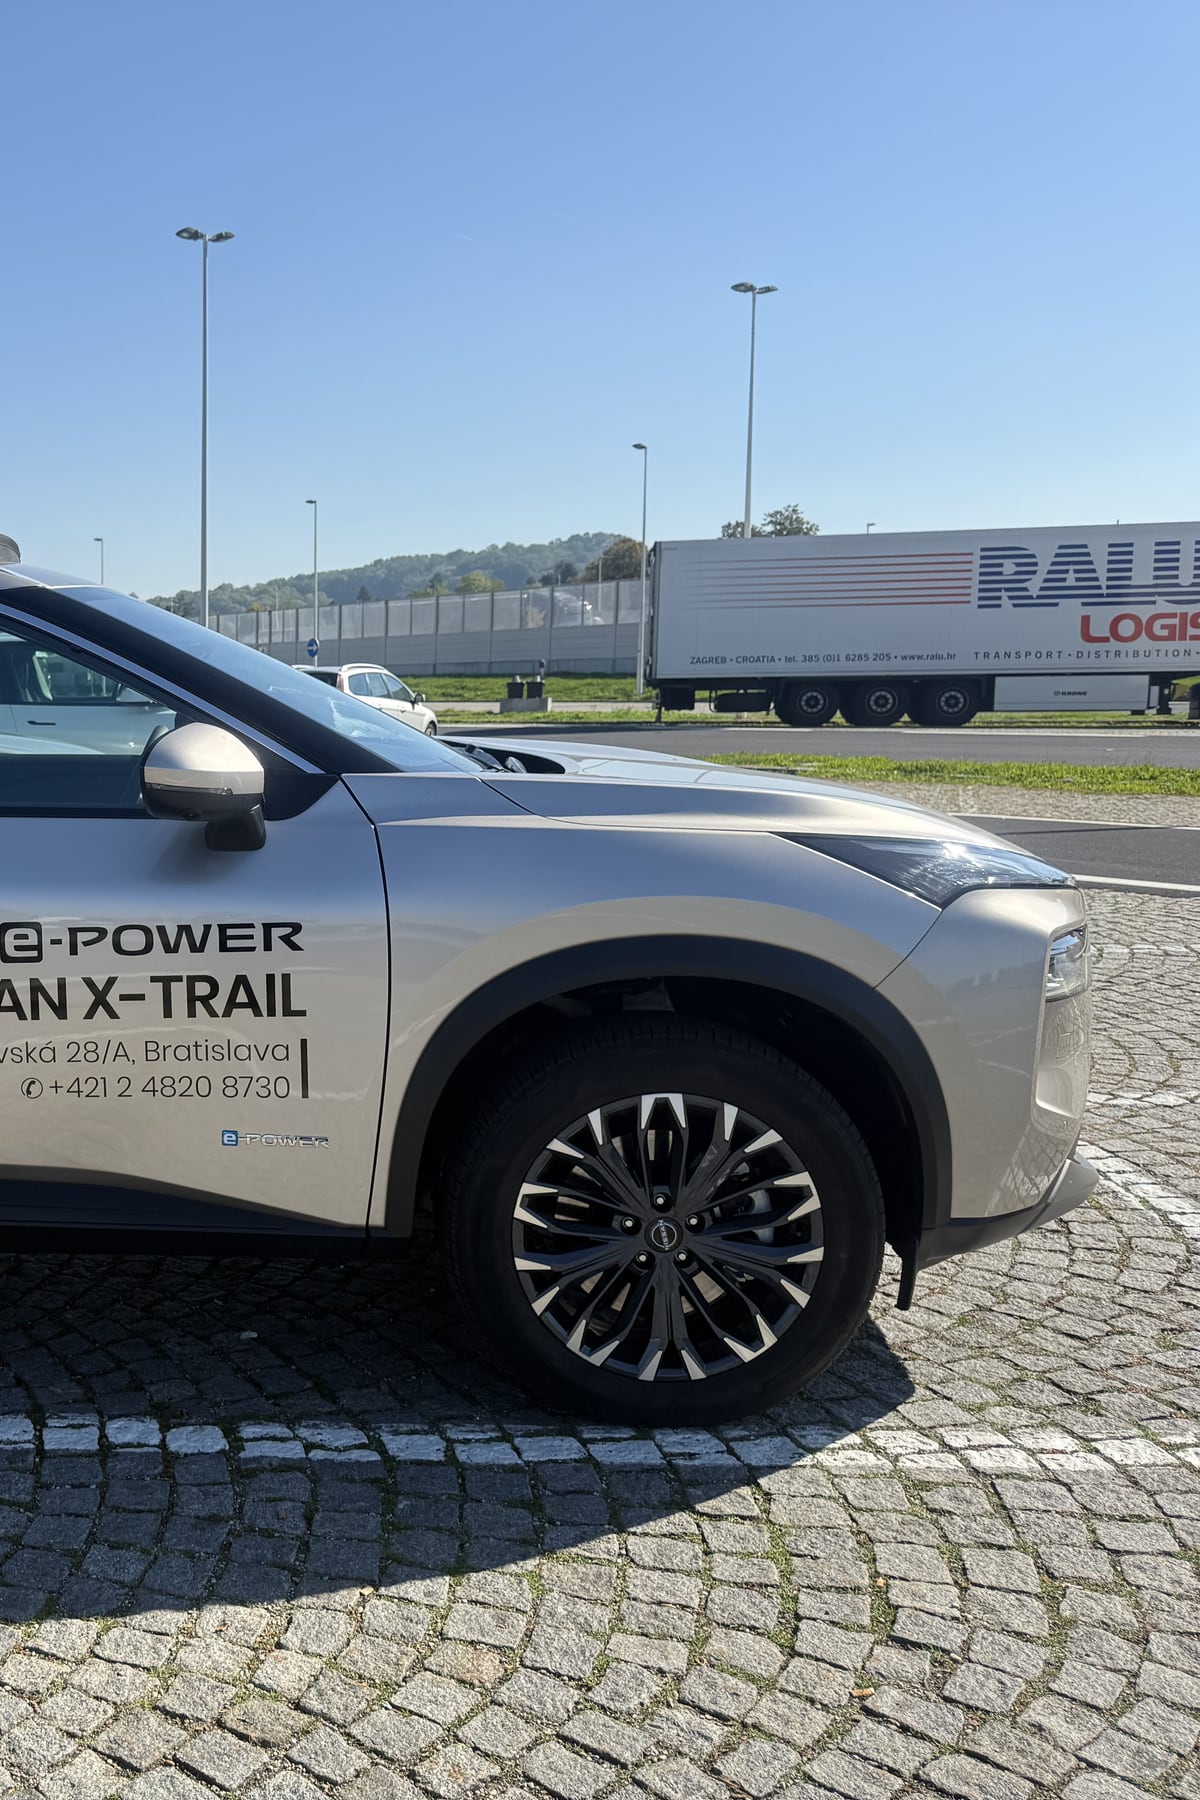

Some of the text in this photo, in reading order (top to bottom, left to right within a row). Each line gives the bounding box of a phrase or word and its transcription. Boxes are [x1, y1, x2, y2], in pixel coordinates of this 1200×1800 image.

[977, 540, 1200, 609] RALU
[690, 652, 957, 665] ZAGREB CROATIA tel. 385 (0)1 6285 205 www.ralu.hr
[974, 648, 1192, 661] TRANSPORT DISTRIBUTION
[82, 973, 306, 1019] X-TRAIL
[67, 1040, 135, 1065] 28/A,
[145, 1039, 289, 1061] Bratislava
[50, 1076, 289, 1098] +421 2 4820 8730
